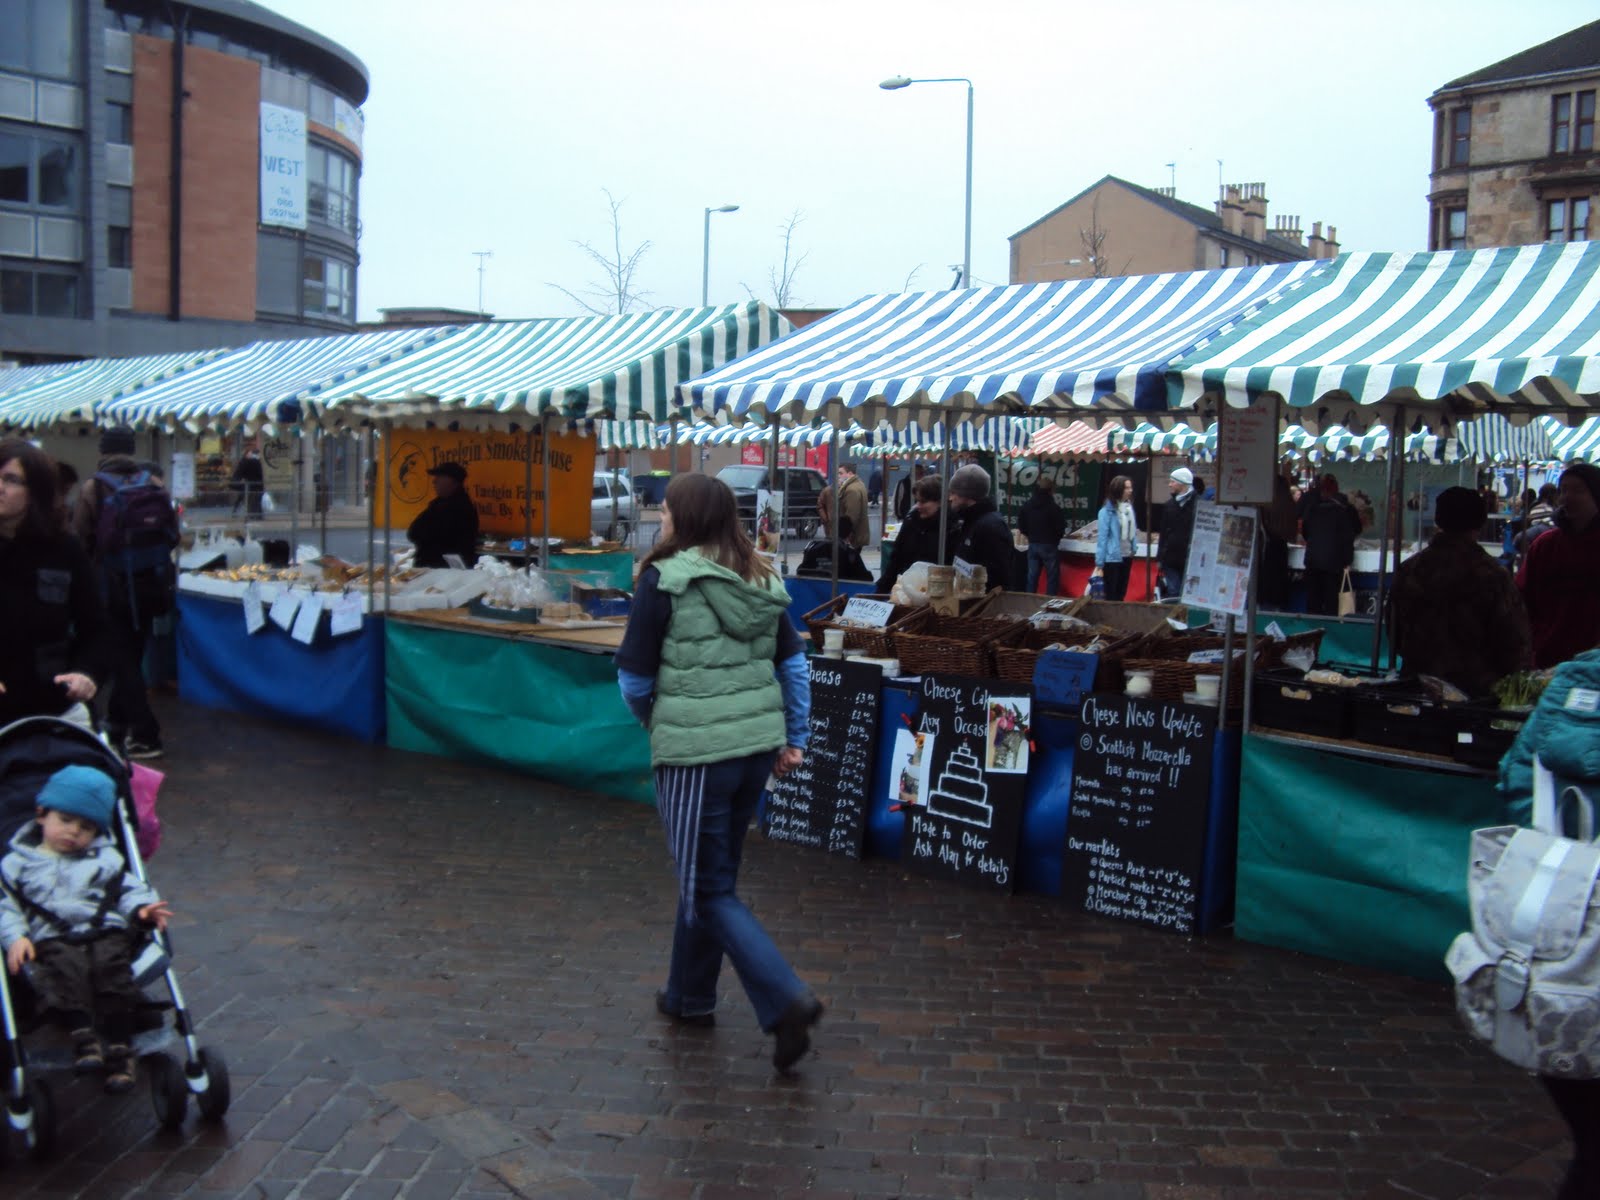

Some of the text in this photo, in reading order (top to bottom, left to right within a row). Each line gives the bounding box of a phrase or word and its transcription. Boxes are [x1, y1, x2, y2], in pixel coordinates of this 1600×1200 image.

[264, 155, 300, 177] WEST
[486, 437, 529, 462] Smoke
[534, 440, 573, 472] Huse
[499, 502, 513, 519] By
[519, 505, 537, 519] Ar
[1053, 493, 1089, 510] Bars
[808, 659, 842, 687] heese
[924, 677, 990, 711] Cheese Cak
[919, 711, 988, 738] Any Occasi
[1082, 697, 1203, 740] Cheese News Update
[1096, 734, 1191, 766] Scottish Mozzarella
[1106, 758, 1122, 777] has
[1127, 766, 1163, 783] arrived
[912, 815, 989, 850] Made to Order
[913, 837, 933, 857] Ask
[977, 854, 1009, 884] details
[1069, 837, 1120, 858] Our markets
[1127, 861, 1146, 878] Park
